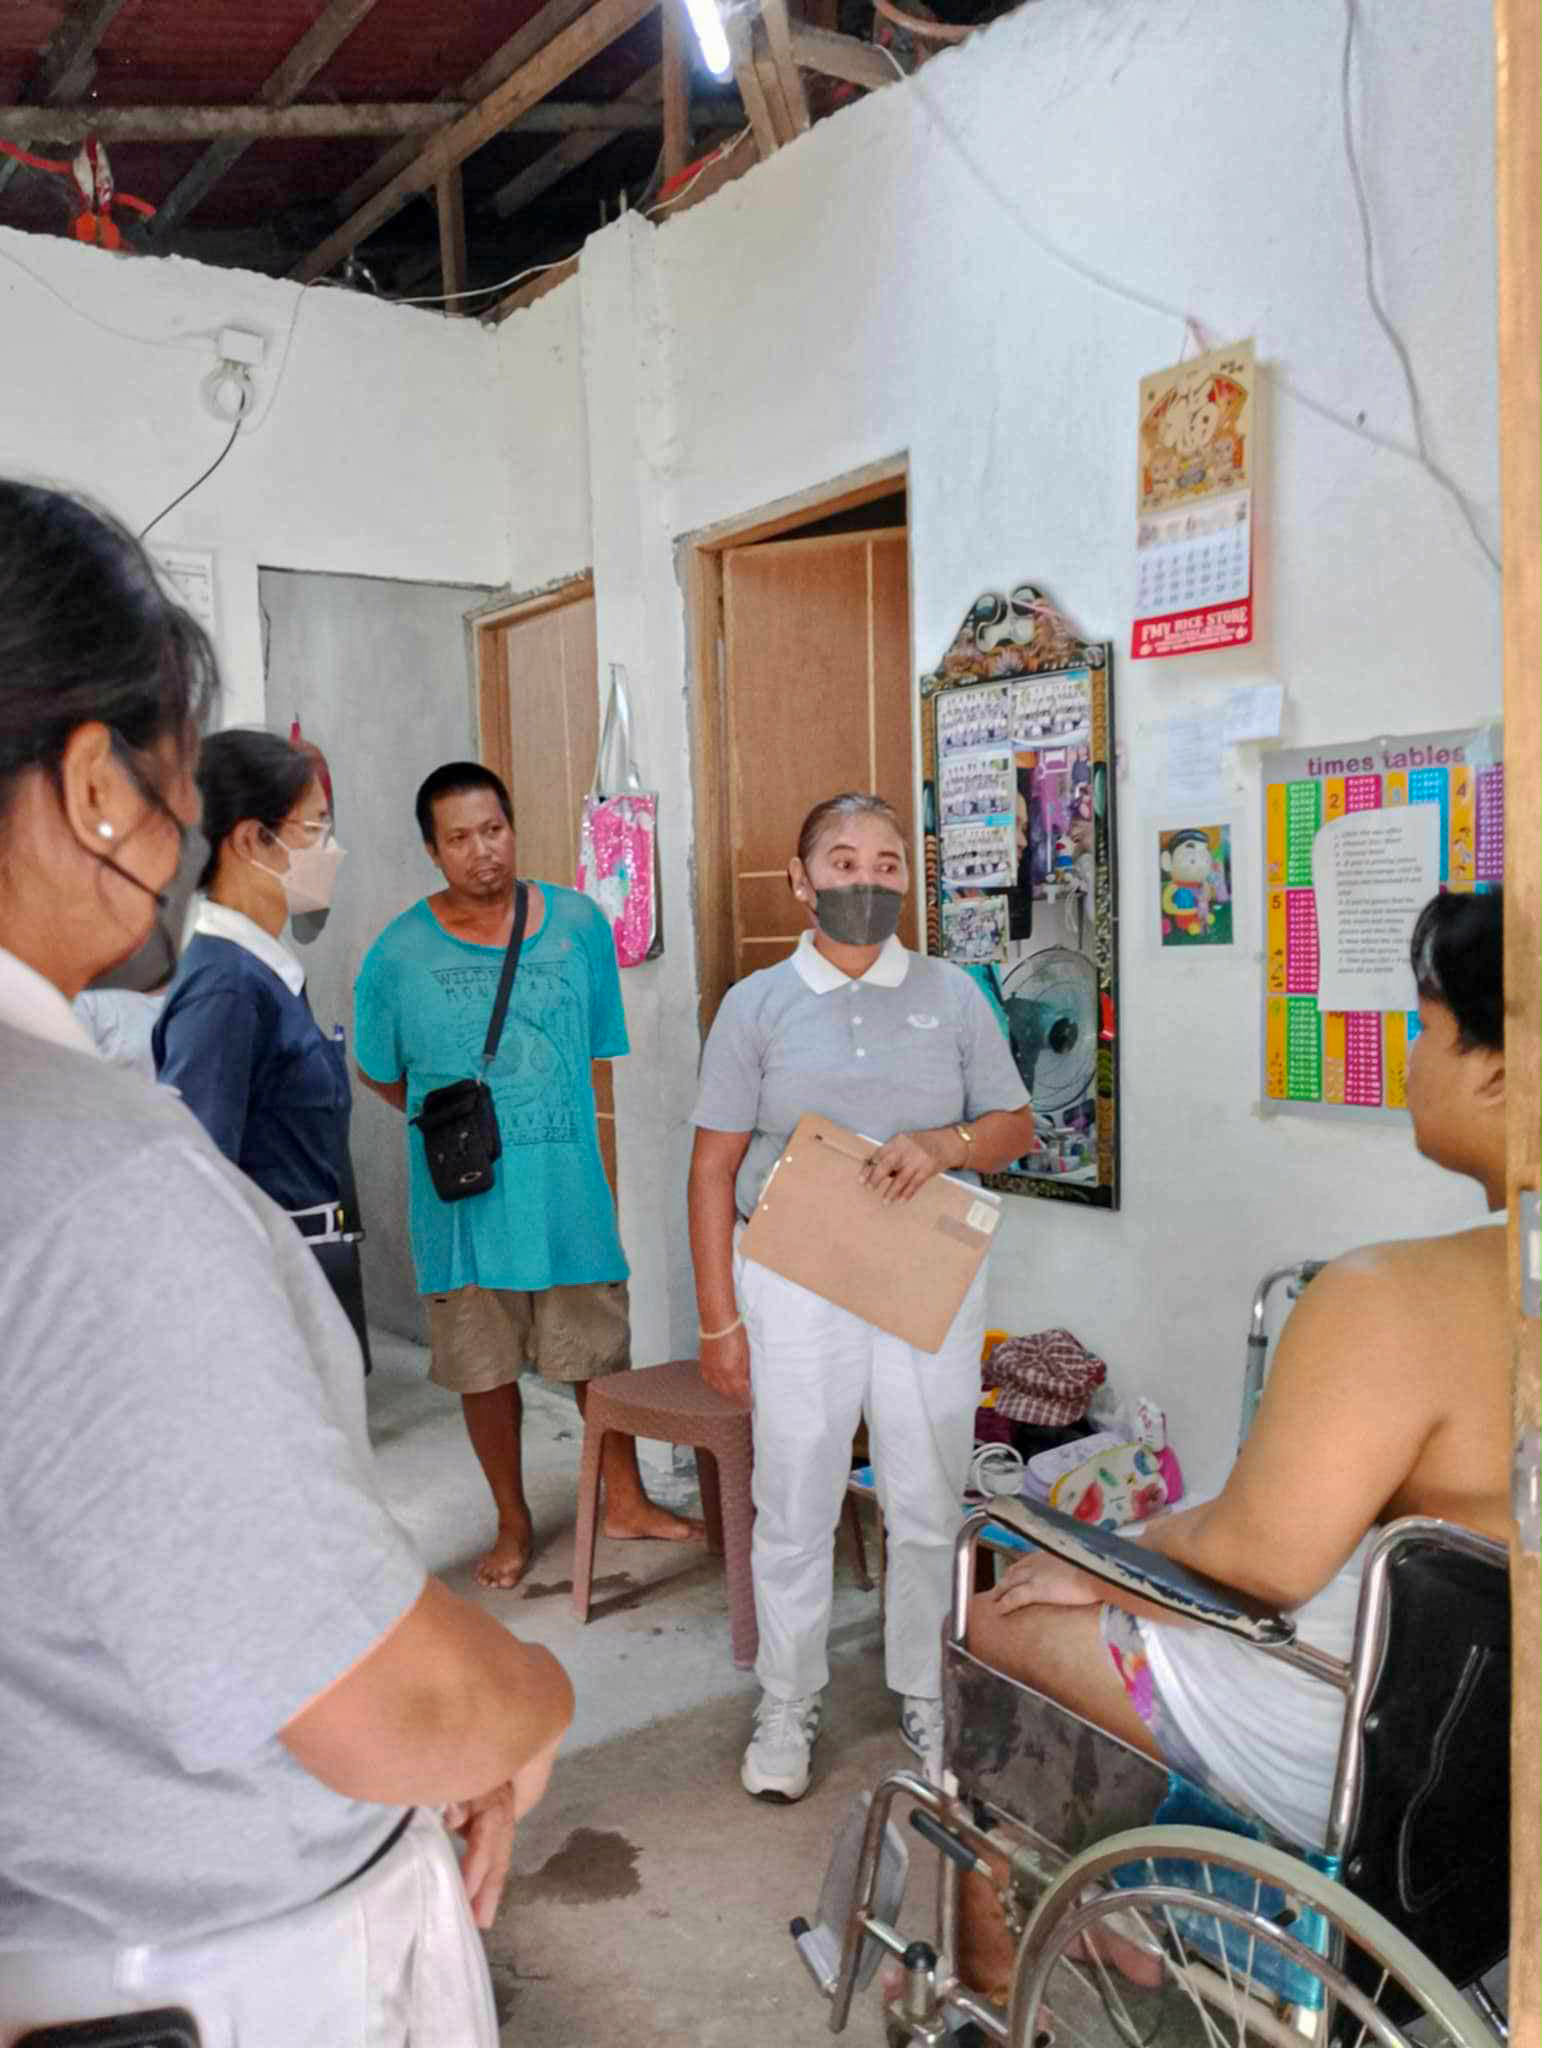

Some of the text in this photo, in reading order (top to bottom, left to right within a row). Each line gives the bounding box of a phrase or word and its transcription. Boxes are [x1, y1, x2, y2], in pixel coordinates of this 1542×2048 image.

[1206, 606, 1247, 627] STORE
[1308, 745, 1466, 777] times tables
[1455, 781, 1467, 798] 4
[1329, 793, 1341, 810] 2
[1271, 895, 1281, 910] 5
